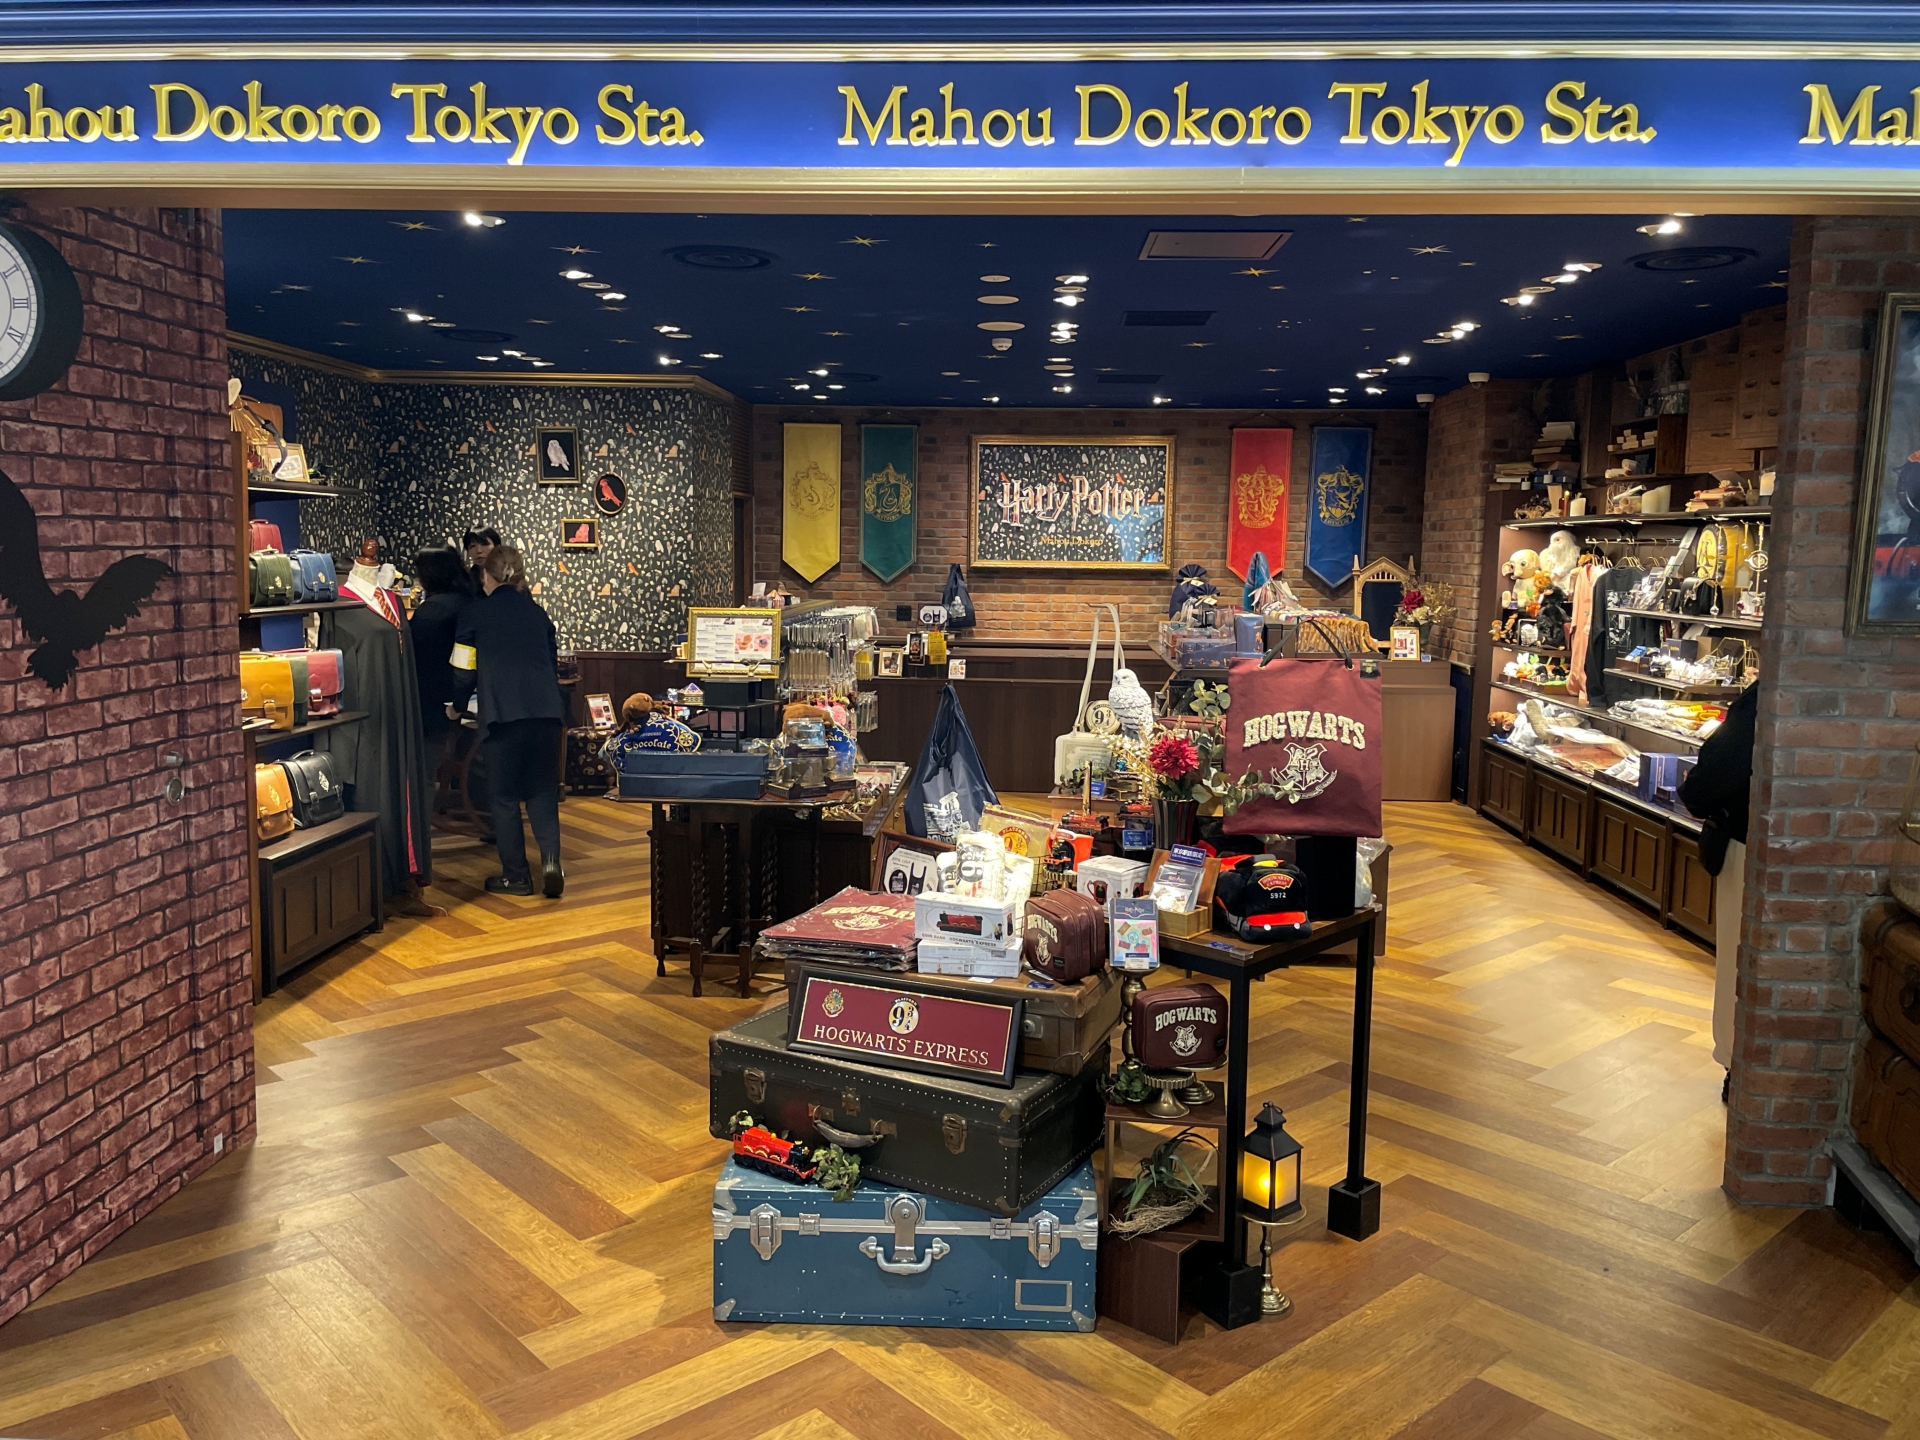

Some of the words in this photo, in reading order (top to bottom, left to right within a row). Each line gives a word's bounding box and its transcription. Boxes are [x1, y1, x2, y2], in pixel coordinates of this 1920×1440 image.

[0, 82, 140, 143] ahou
[148, 79, 381, 142] Dokoro
[390, 81, 579, 164] Tokyo
[595, 83, 704, 145] Sta.
[836, 84, 1054, 145] Mahou
[1074, 81, 1312, 144] Dokoro
[1327, 81, 1525, 164] Tokyo
[1540, 80, 1658, 143] Sta.
[997, 478, 1069, 528] Harry
[1070, 475, 1145, 532] Potter
[623, 738, 672, 752] Chocolate
[1242, 710, 1366, 750] HOGWARTS
[975, 940, 997, 948] EXPRESS
[1155, 1006, 1218, 1032] HOGWARTS
[913, 1040, 989, 1066] EXPRESS
